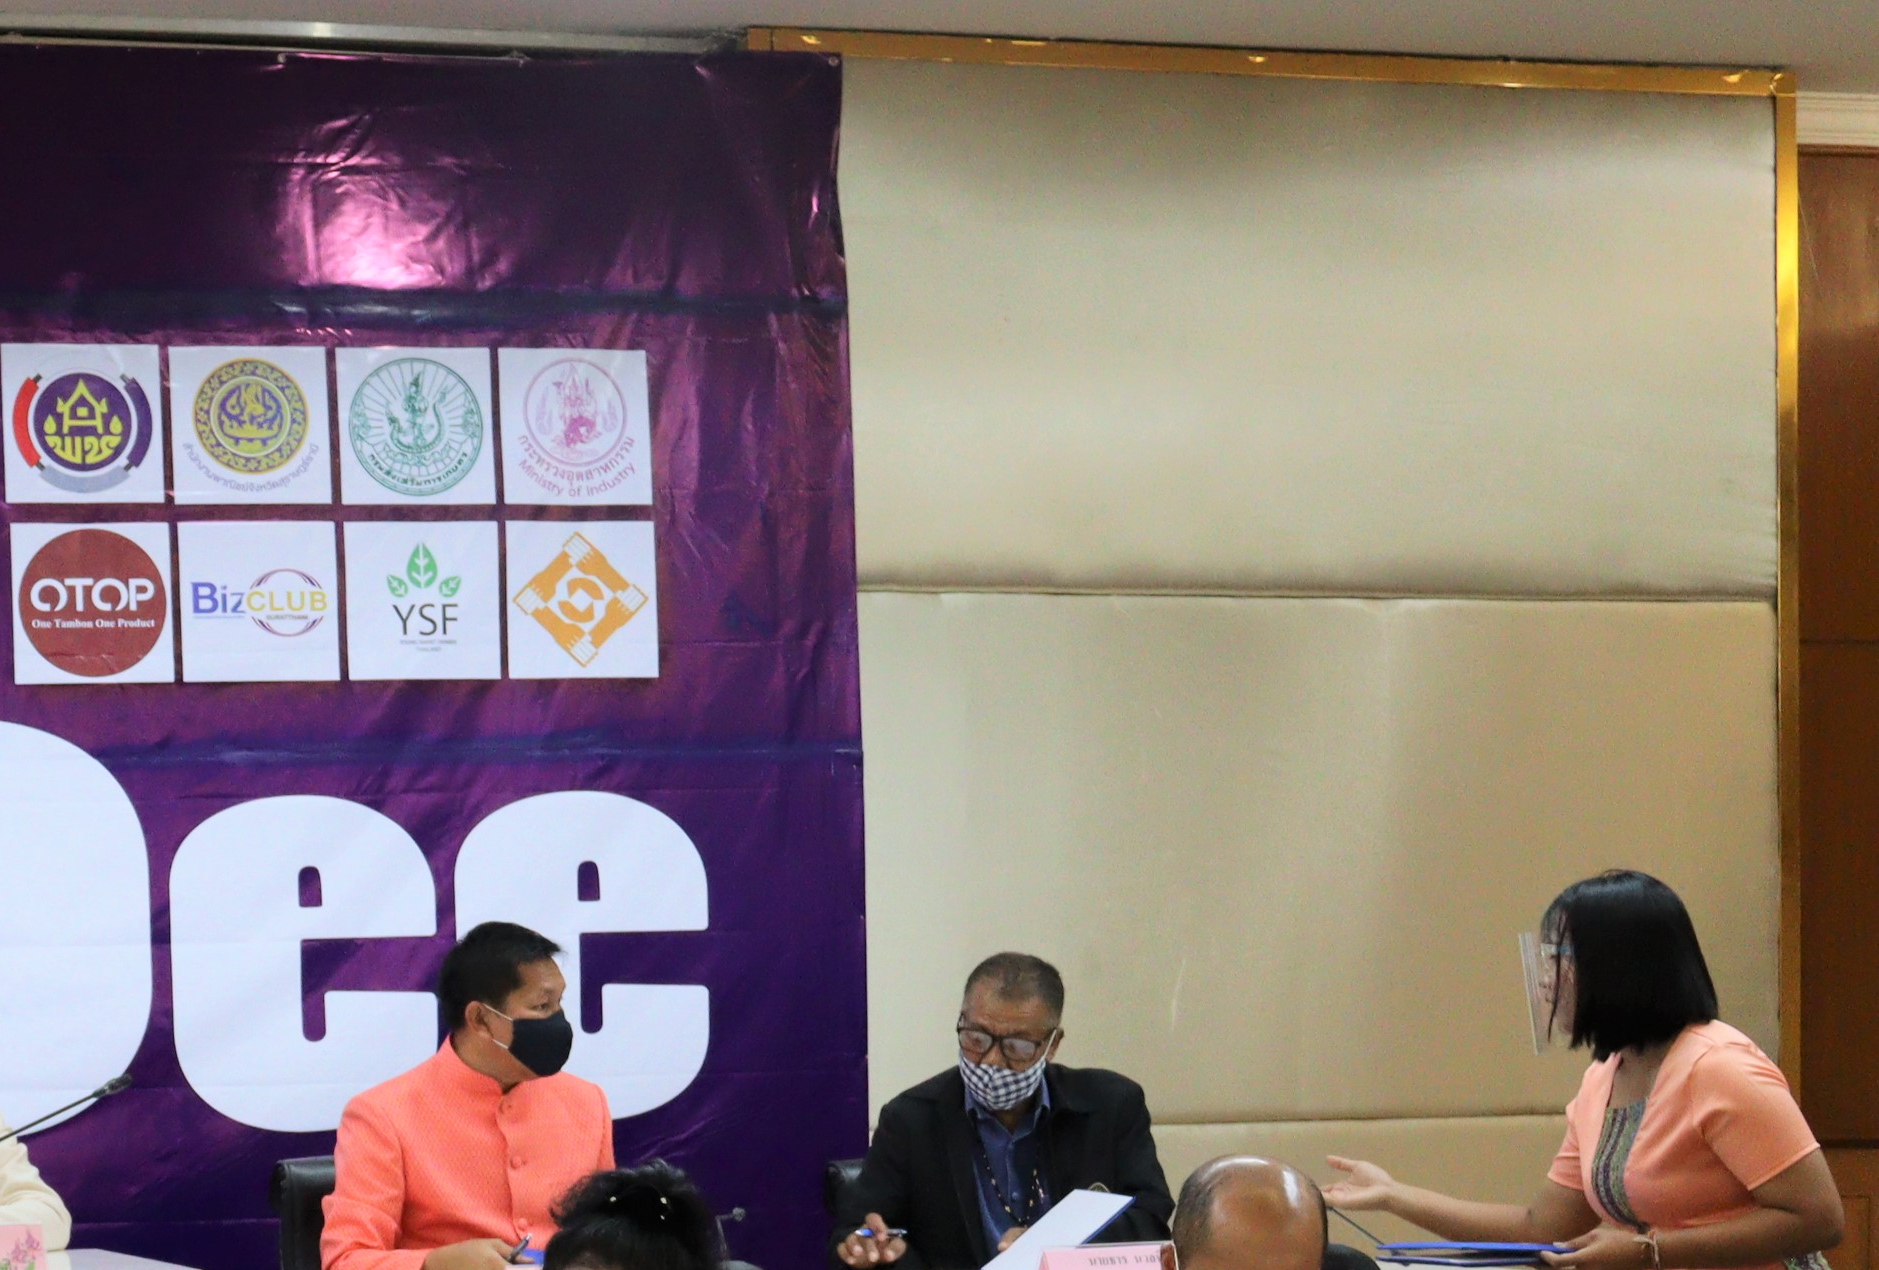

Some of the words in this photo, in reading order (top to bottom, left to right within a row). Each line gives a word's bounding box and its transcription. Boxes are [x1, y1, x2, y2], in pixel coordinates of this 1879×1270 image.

[519, 459, 564, 497] Ministry
[568, 485, 582, 498] of
[30, 577, 156, 612] OTOP
[31, 619, 52, 629] One
[54, 619, 94, 628] Tambon
[95, 619, 116, 628] One
[117, 618, 156, 628] Product
[392, 603, 459, 636] YSF
